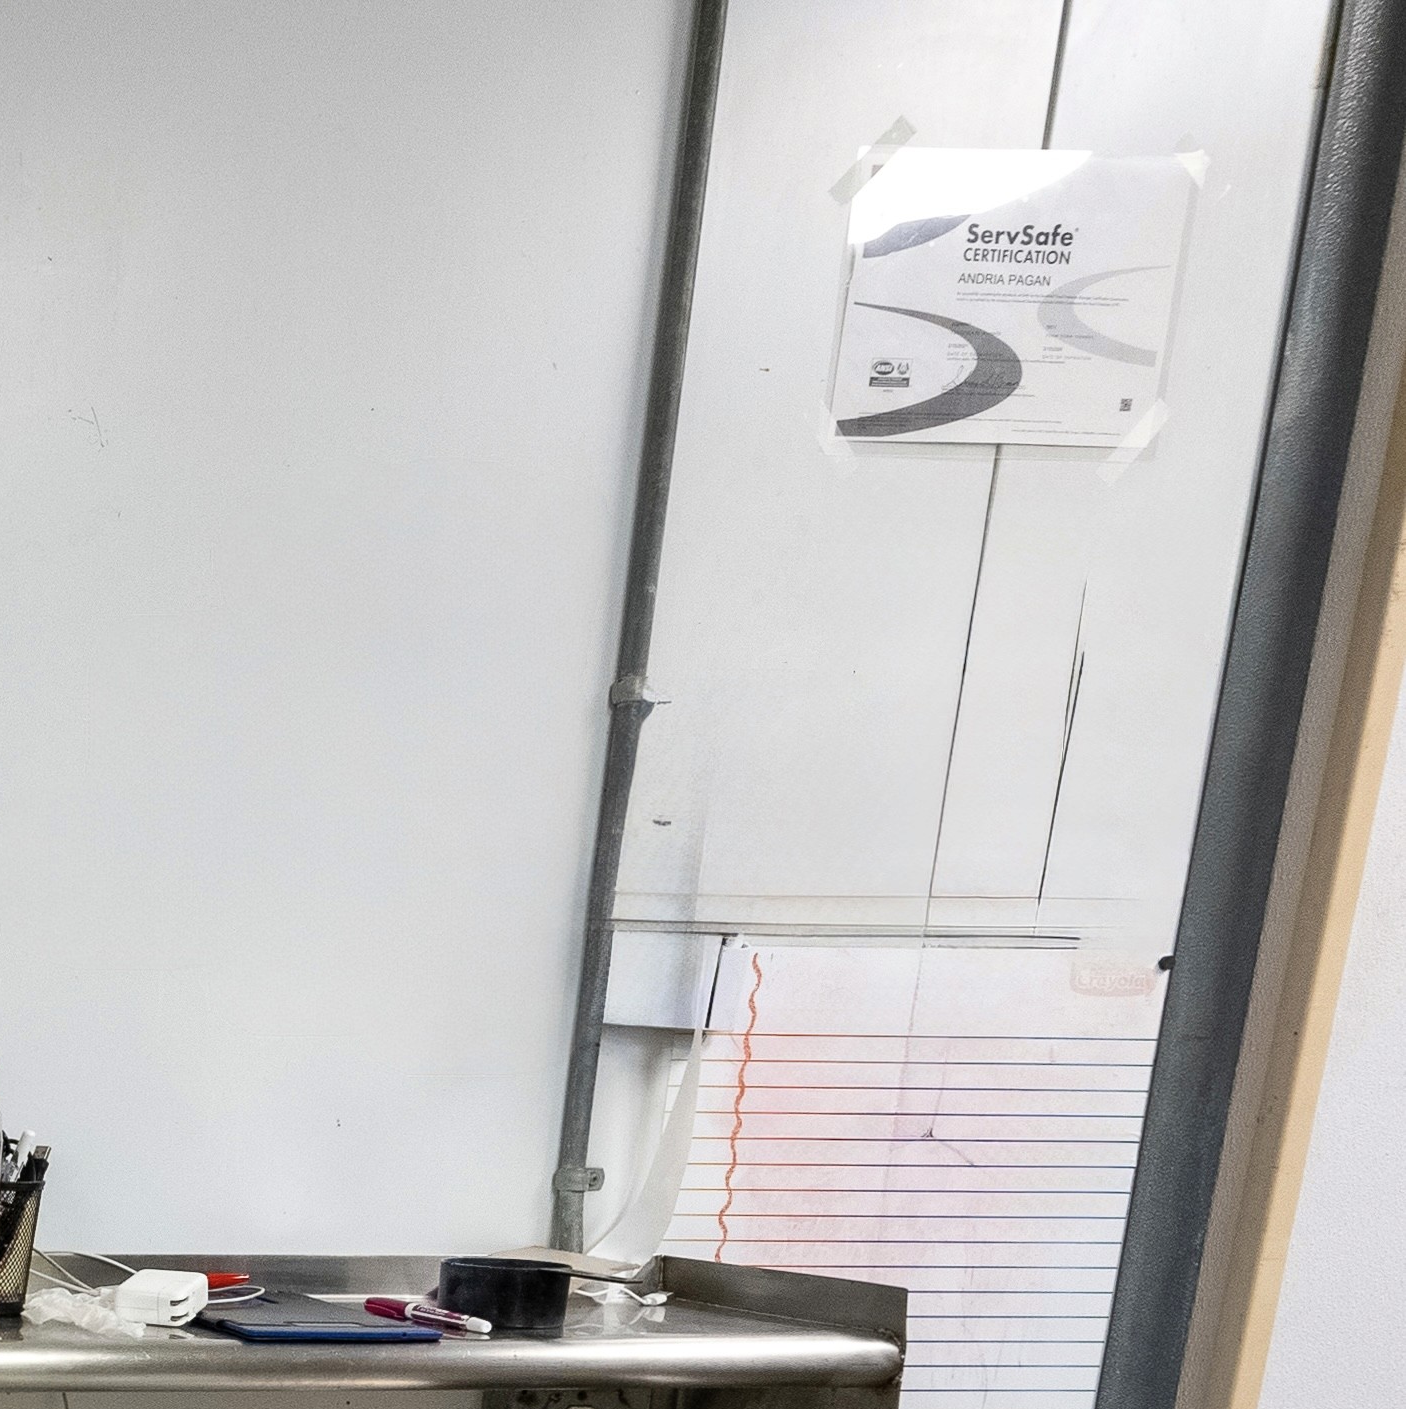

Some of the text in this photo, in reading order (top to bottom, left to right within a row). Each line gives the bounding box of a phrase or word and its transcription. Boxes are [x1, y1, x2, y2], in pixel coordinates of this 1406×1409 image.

[966, 223, 1074, 246] ServSafe
[963, 247, 1072, 265] CERTIFICATION
[957, 272, 1052, 286] ANDRIA PAGAN
